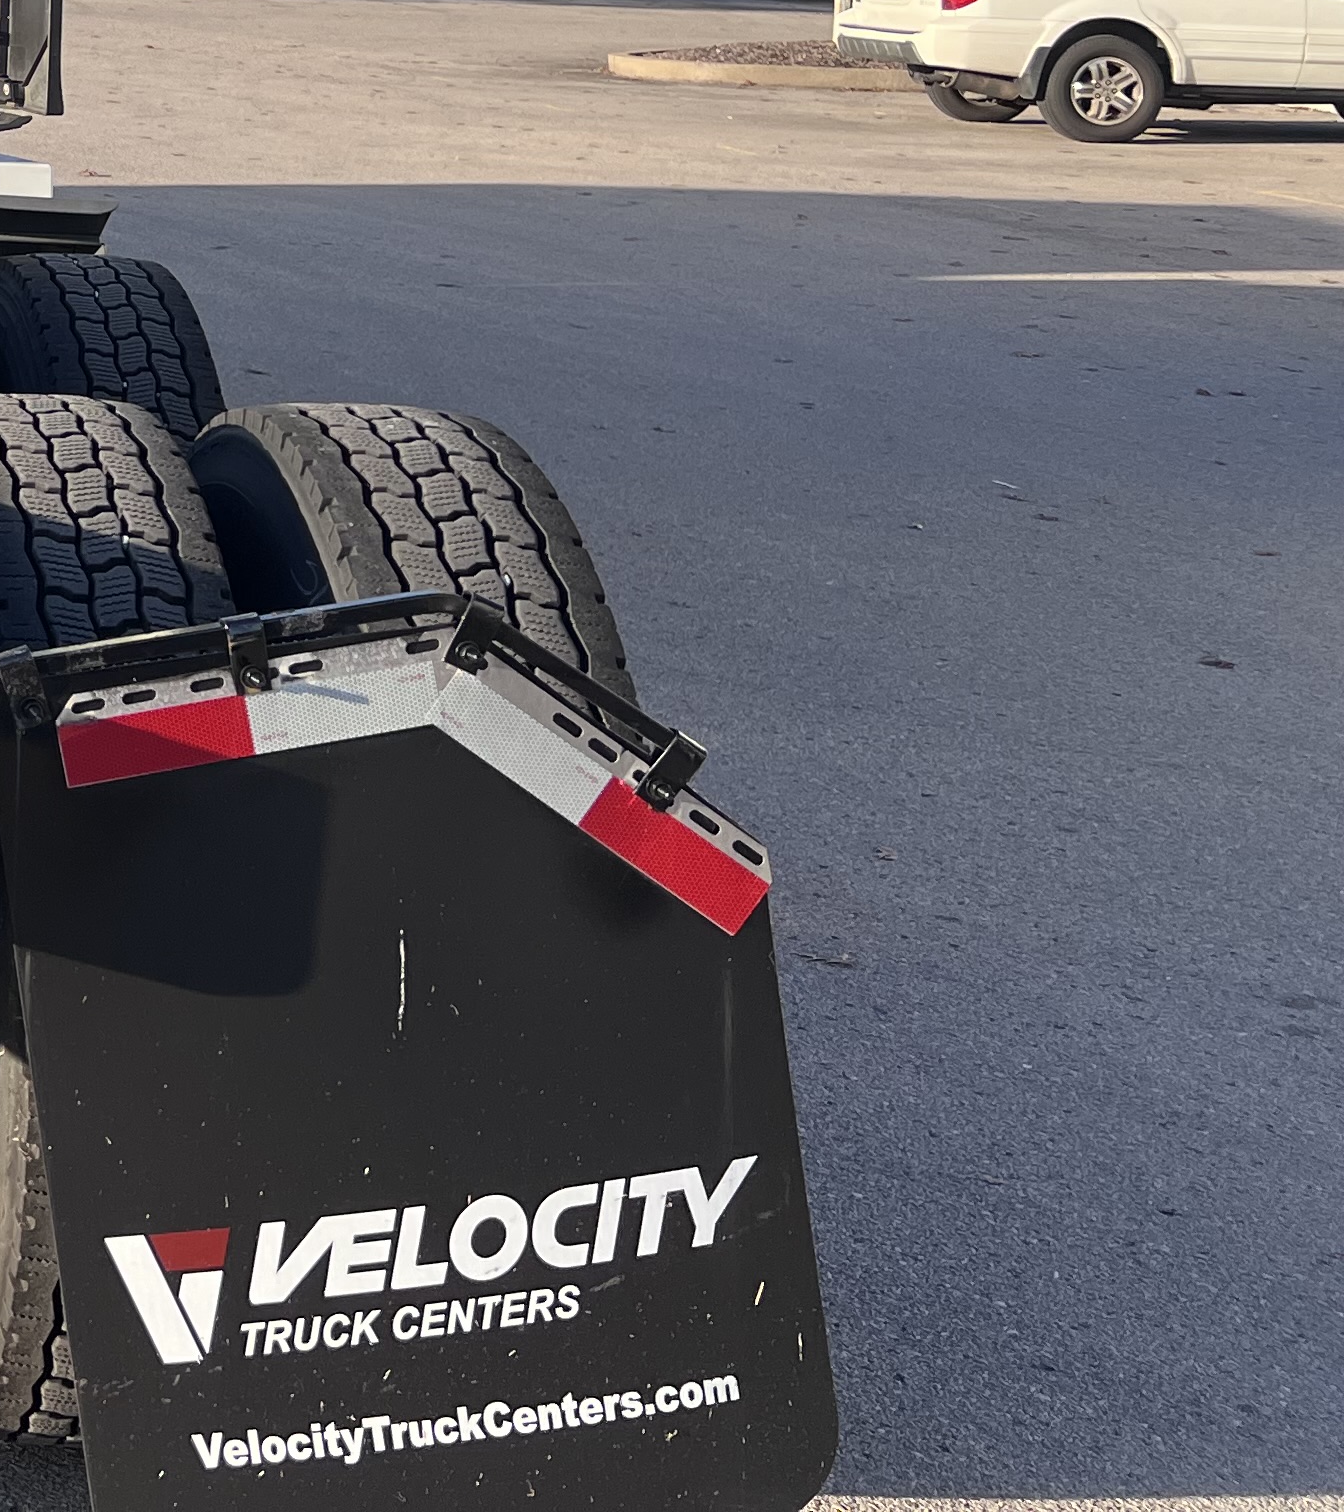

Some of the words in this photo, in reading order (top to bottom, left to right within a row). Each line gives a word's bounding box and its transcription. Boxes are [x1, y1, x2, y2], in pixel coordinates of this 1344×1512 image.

[248, 1154, 760, 1306] VELOCITY
[240, 1309, 382, 1357] TRUCK
[392, 1284, 582, 1342] CENTERS
[190, 1374, 741, 1471] VelocityTruckCenters.com
